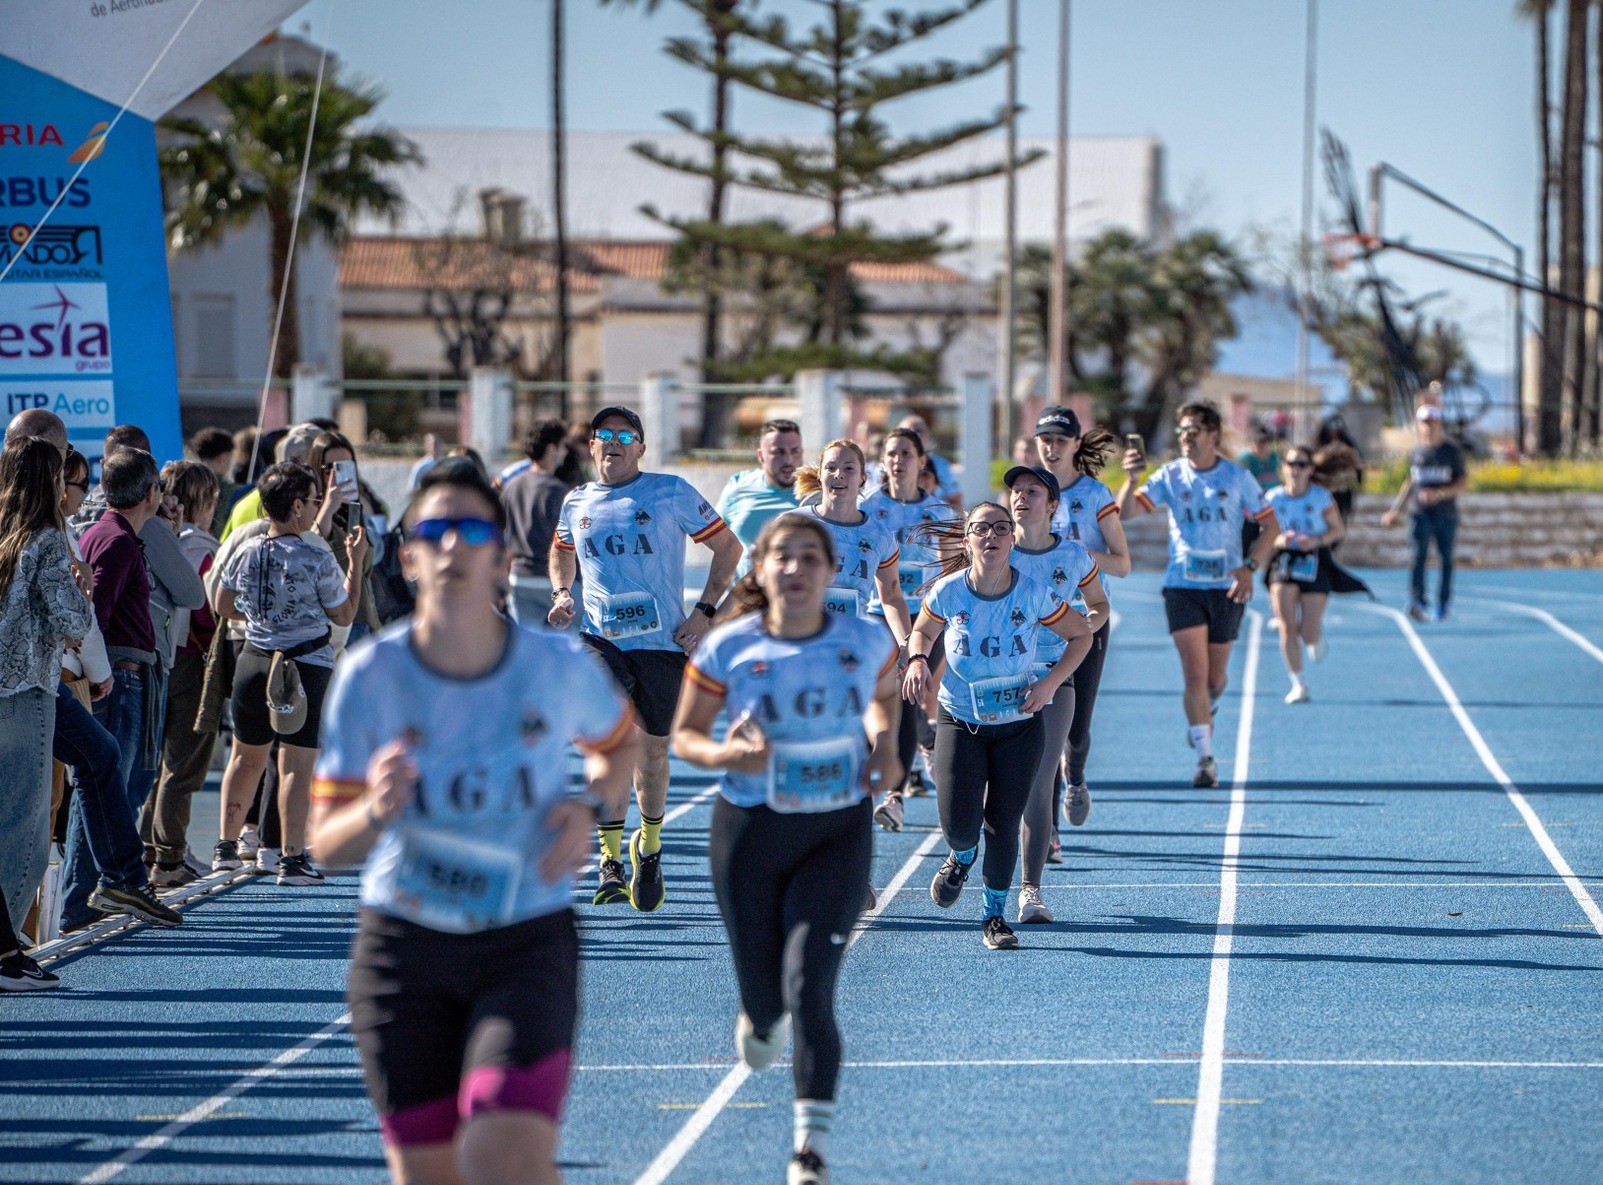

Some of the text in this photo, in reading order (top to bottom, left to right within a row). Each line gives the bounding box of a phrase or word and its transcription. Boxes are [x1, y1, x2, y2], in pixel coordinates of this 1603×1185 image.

[91, 3, 107, 17] de
[0, 177, 91, 208] BUS
[75, 360, 110, 372] grupo
[53, 392, 110, 415] Aero
[1038, 414, 1071, 425] adidas
[1183, 507, 1228, 523] AGA
[584, 533, 654, 559] AGA
[615, 604, 646, 621] 596
[823, 602, 846, 615] 94
[953, 634, 1028, 658] AGA
[992, 686, 1021, 703] 757
[757, 686, 862, 723] AGA
